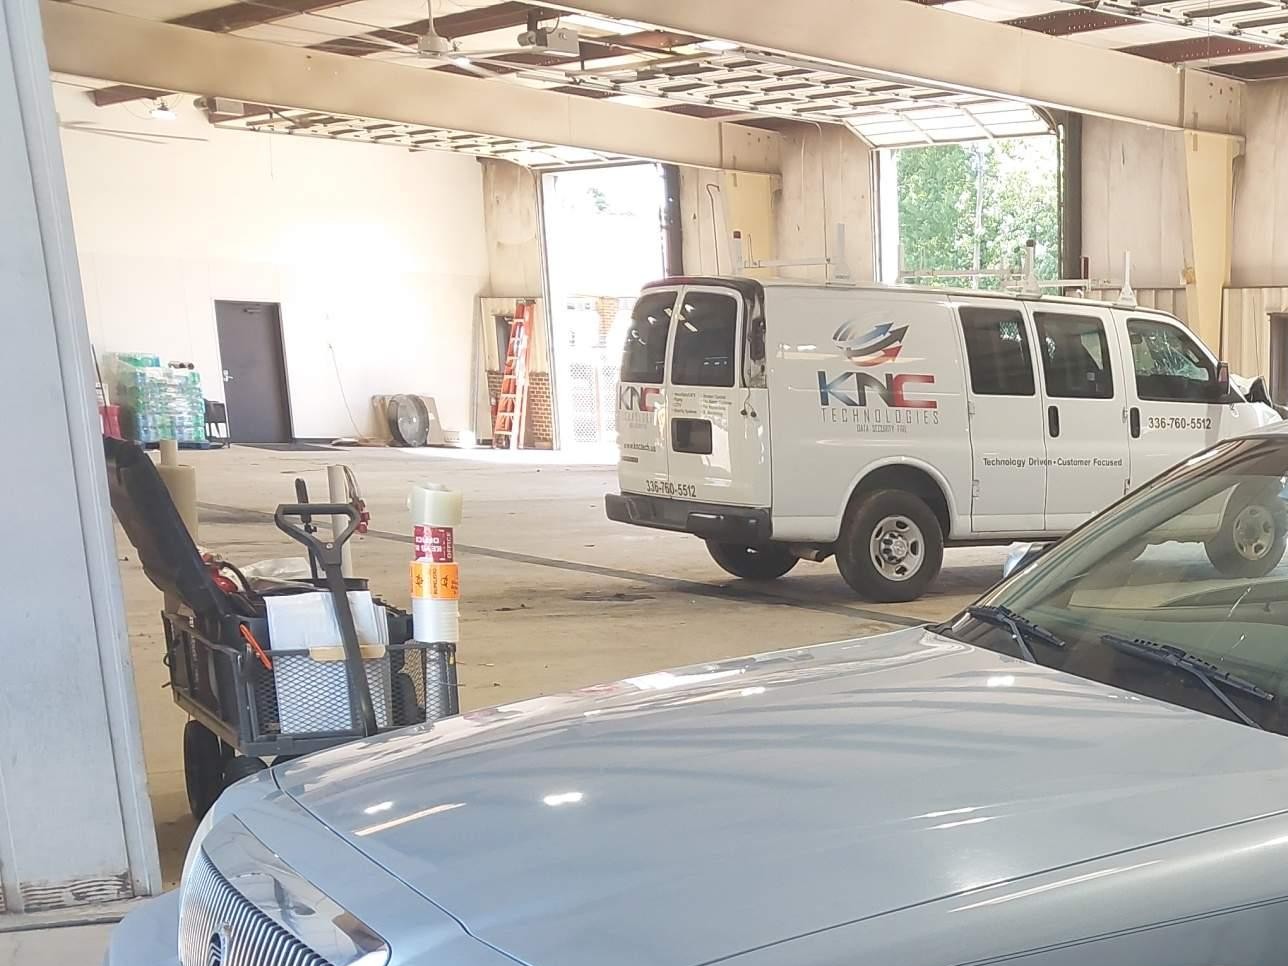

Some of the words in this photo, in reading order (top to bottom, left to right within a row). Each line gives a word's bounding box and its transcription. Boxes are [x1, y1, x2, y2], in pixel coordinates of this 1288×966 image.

[817, 370, 938, 409] KNC
[821, 408, 939, 425] TECHNOLOGIES
[1148, 417, 1212, 430] 336-760-5512
[983, 457, 1026, 468] Technology
[1093, 457, 1123, 467] Focused
[645, 480, 697, 498] 336-760-5512
